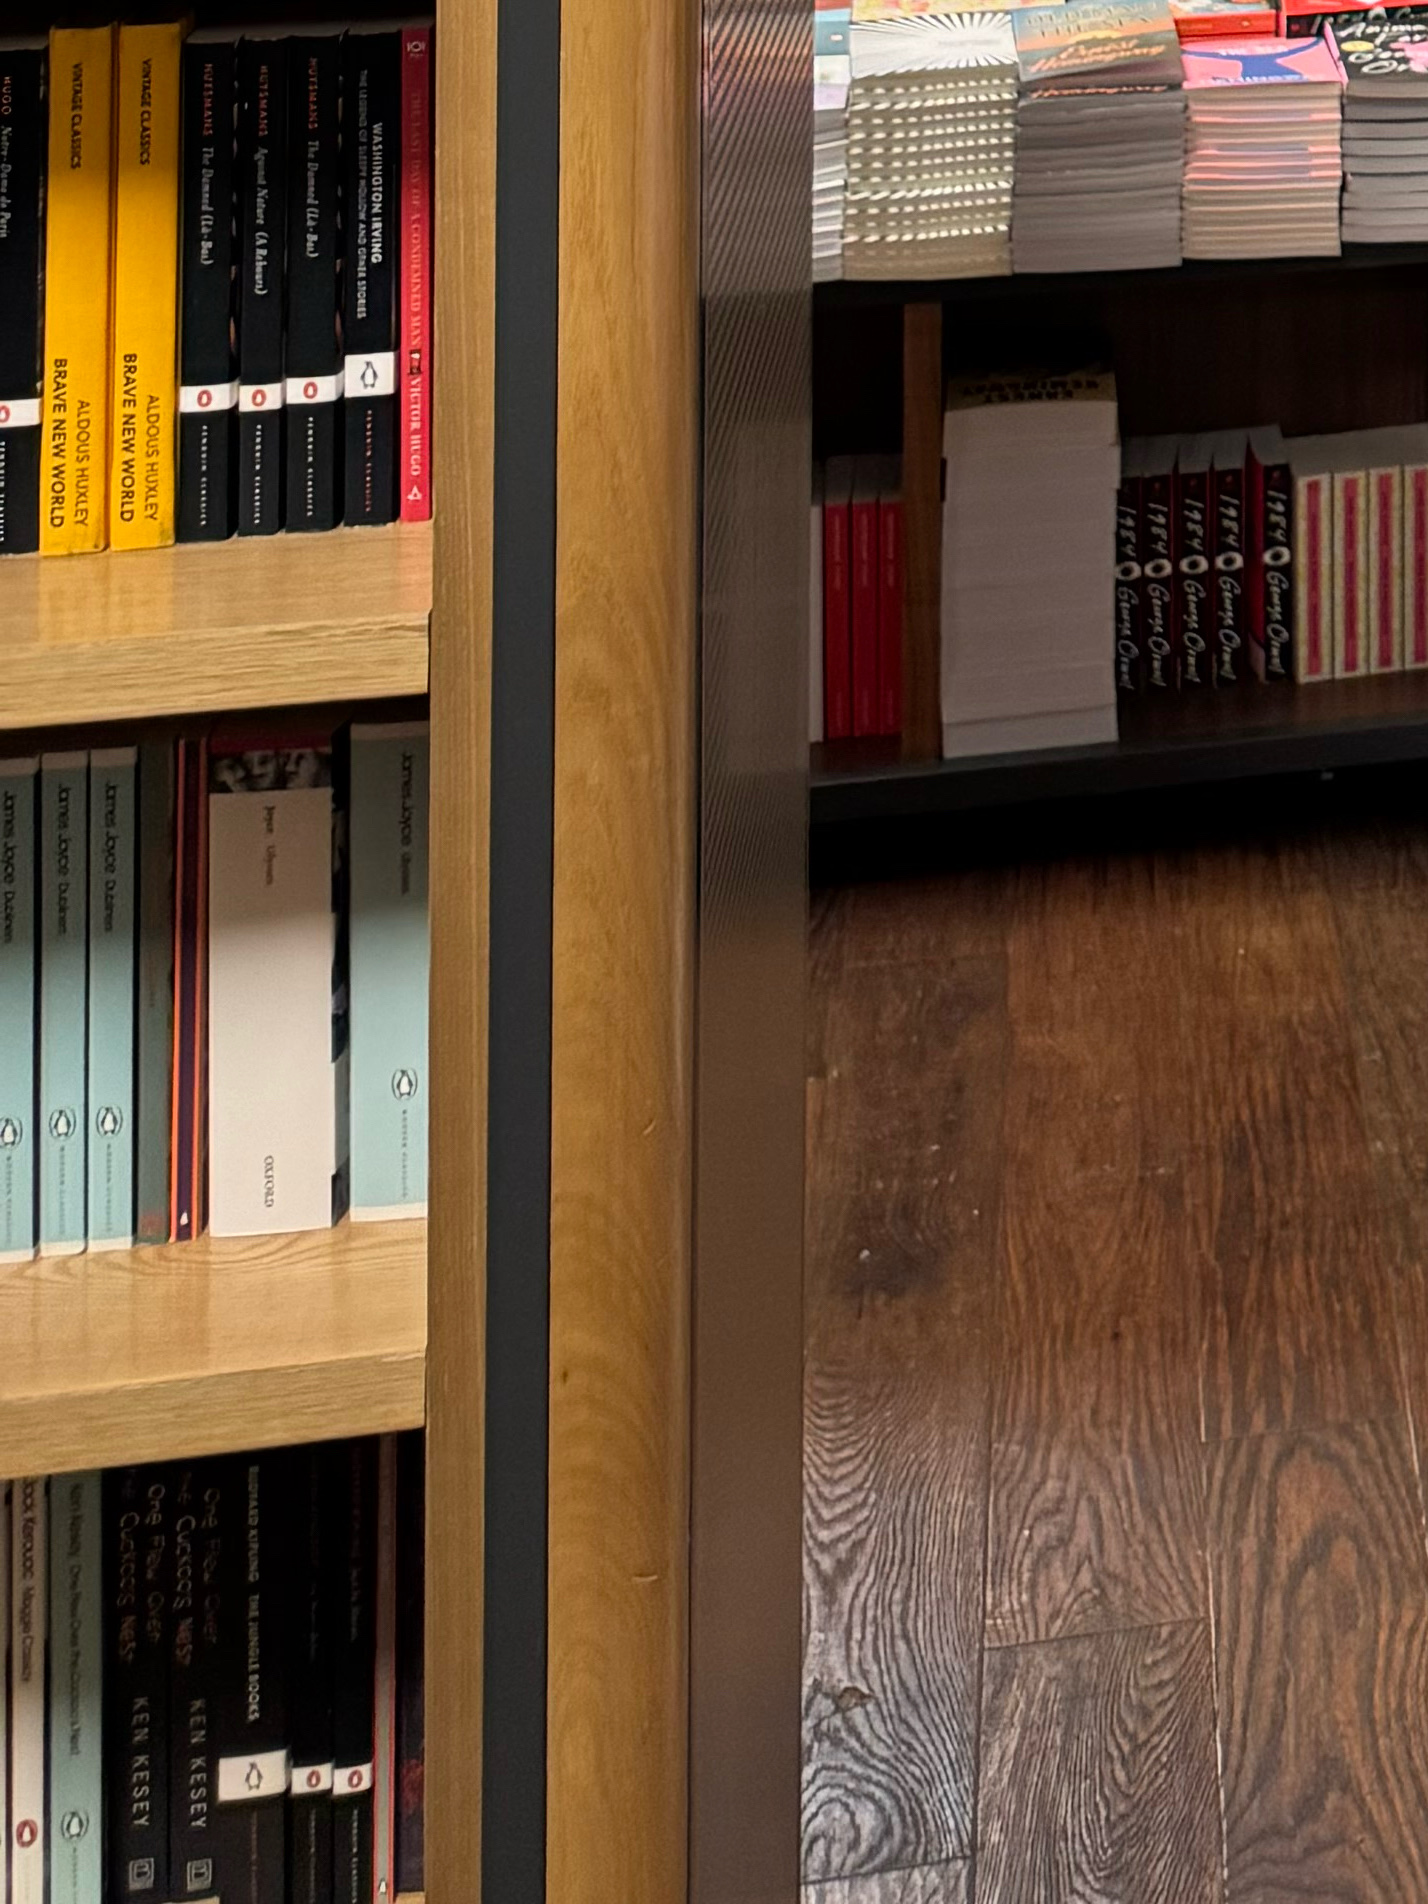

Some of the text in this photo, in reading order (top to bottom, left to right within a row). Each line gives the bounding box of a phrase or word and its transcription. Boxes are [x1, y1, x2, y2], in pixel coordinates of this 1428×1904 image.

[70, 61, 84, 170] VINTAGE CLASSICS
[370, 122, 384, 265] WASHINGTON IRVING
[49, 358, 68, 529] BRAVE NEW WORLD
[73, 399, 91, 528] ALDOUS HUXLEY
[409, 374, 423, 478] VICTOR HUGO
[1147, 502, 1171, 688] 1984 George Orwell
[1218, 494, 1242, 681] 1984 George Orwell
[1266, 490, 1290, 675] 1984 George Orwell
[130, 1696, 151, 1828] KEN KESEY
